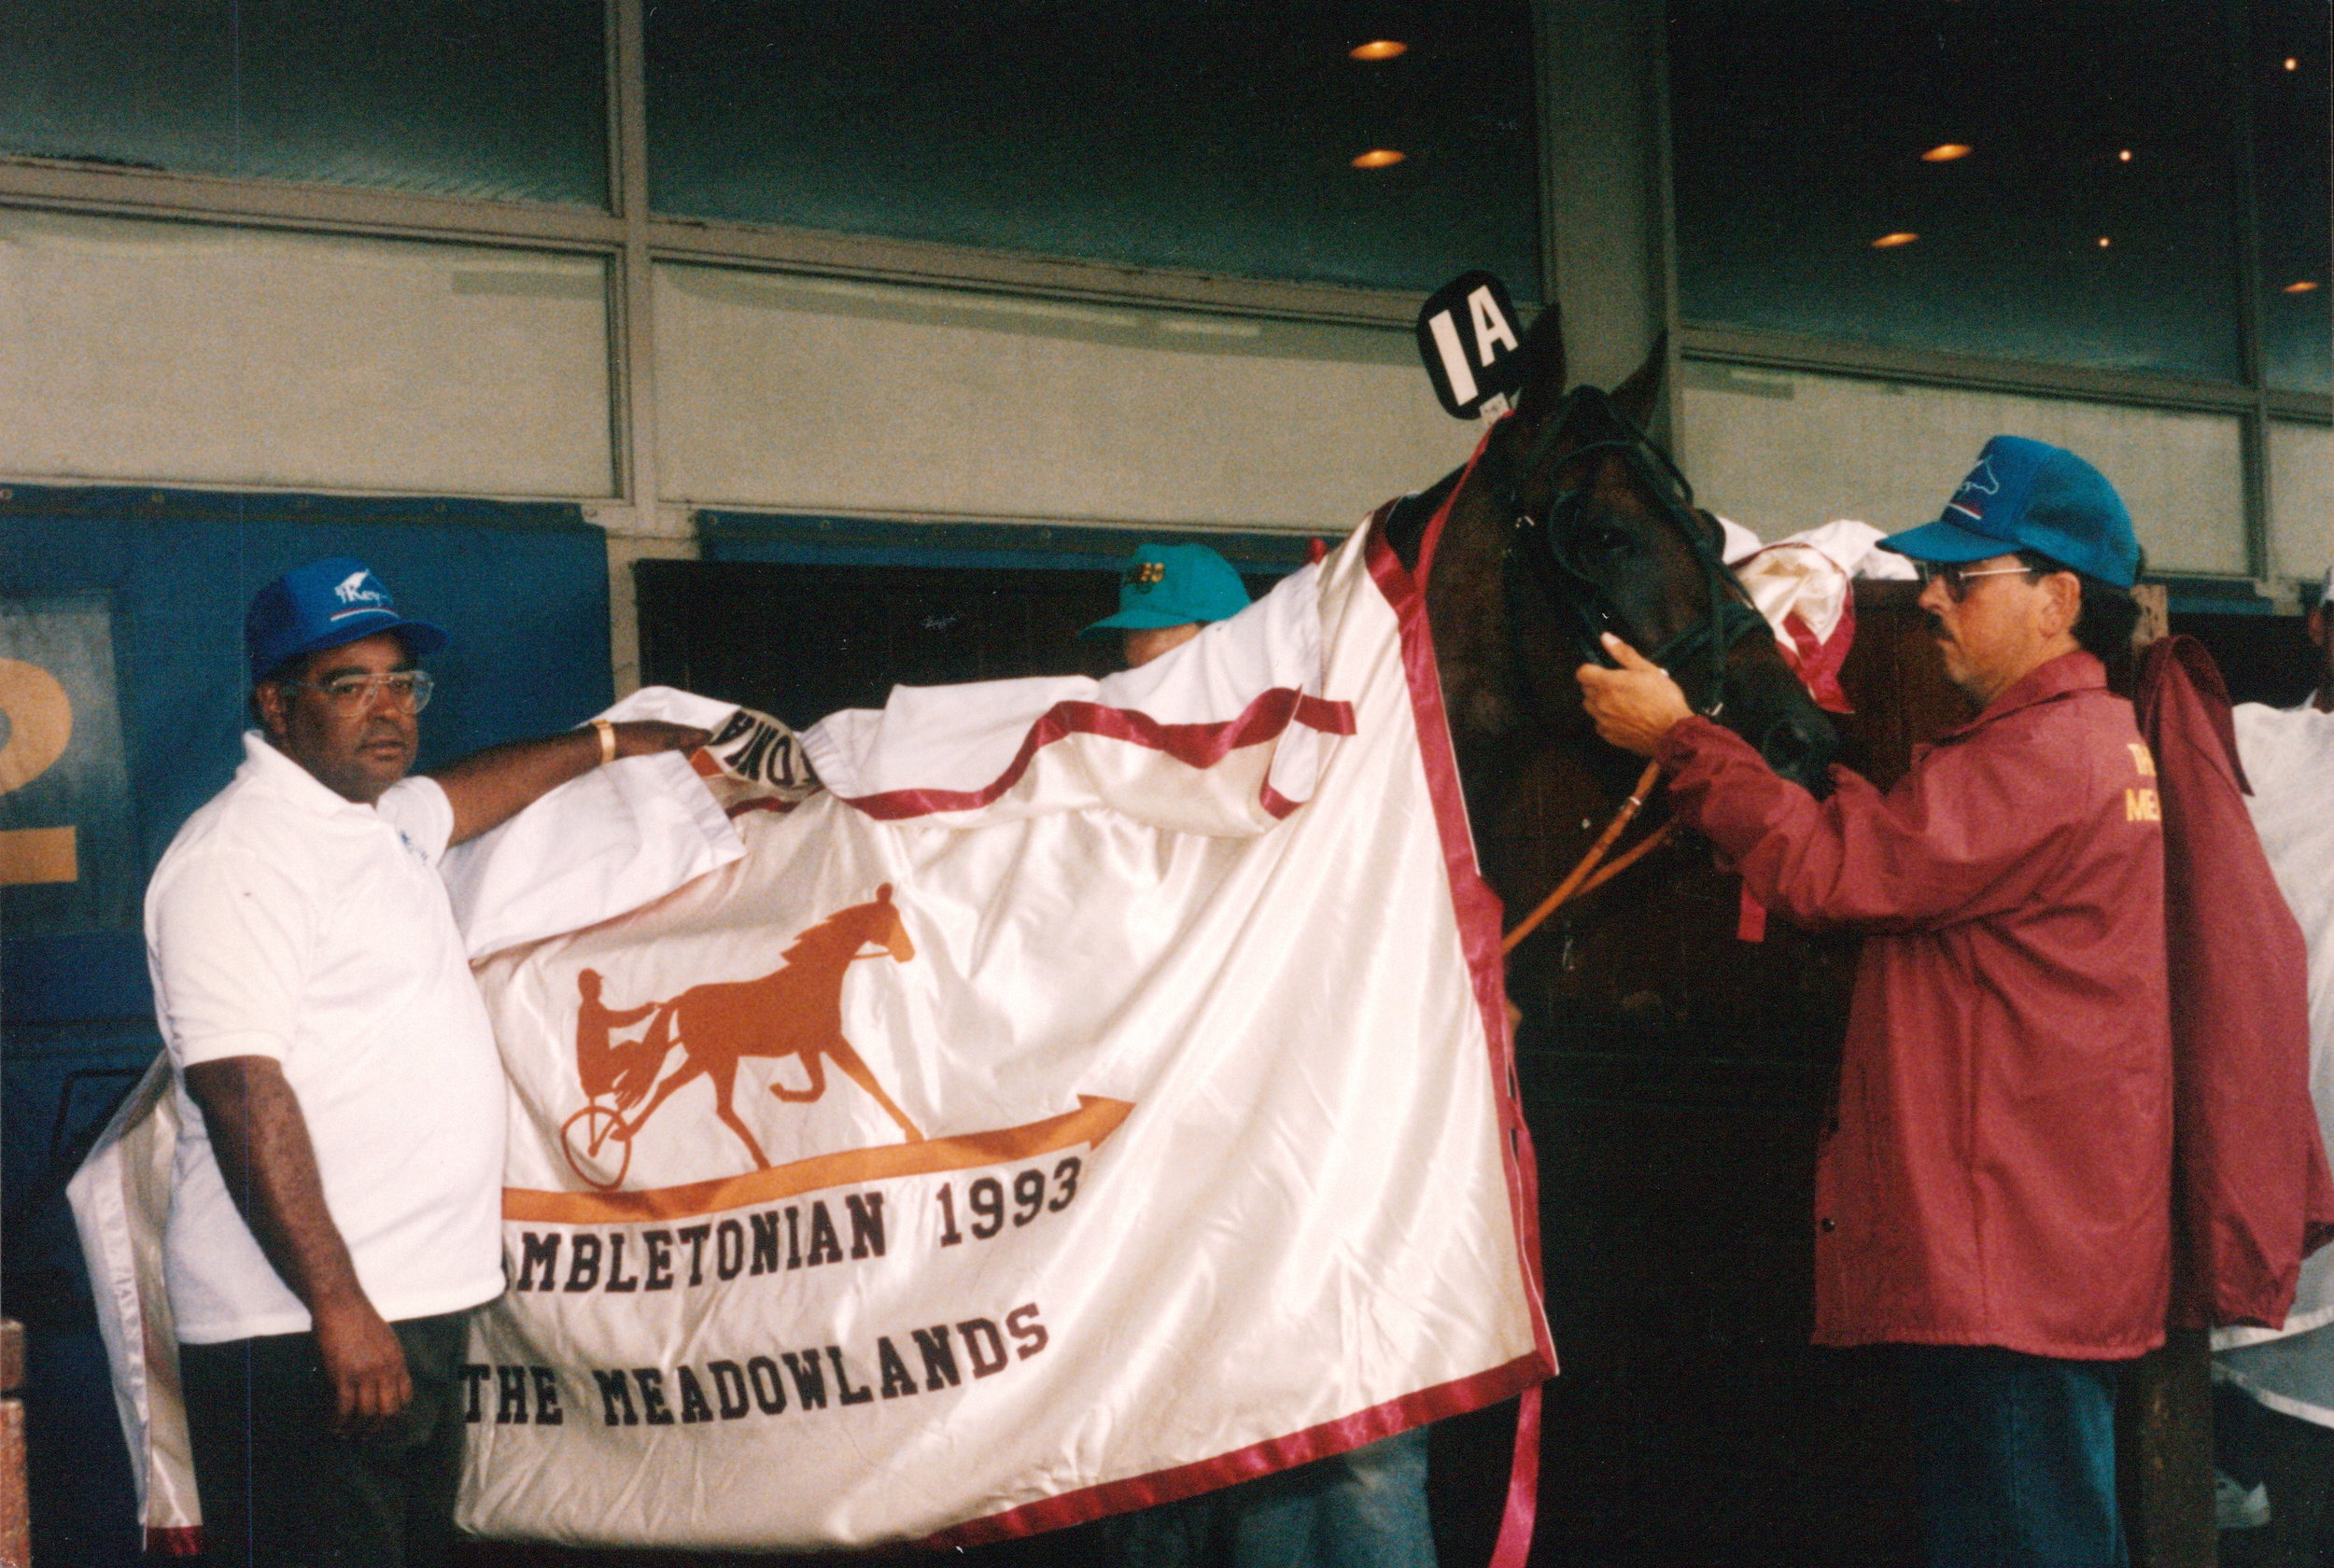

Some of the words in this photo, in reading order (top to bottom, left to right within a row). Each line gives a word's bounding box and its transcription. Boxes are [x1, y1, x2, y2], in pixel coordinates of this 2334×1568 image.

[502, 1191, 886, 1293] MBLETONIAN
[935, 1156, 1082, 1248] 1993
[457, 1364, 563, 1425] THE
[592, 1303, 1049, 1426] MEADOWLANDS
